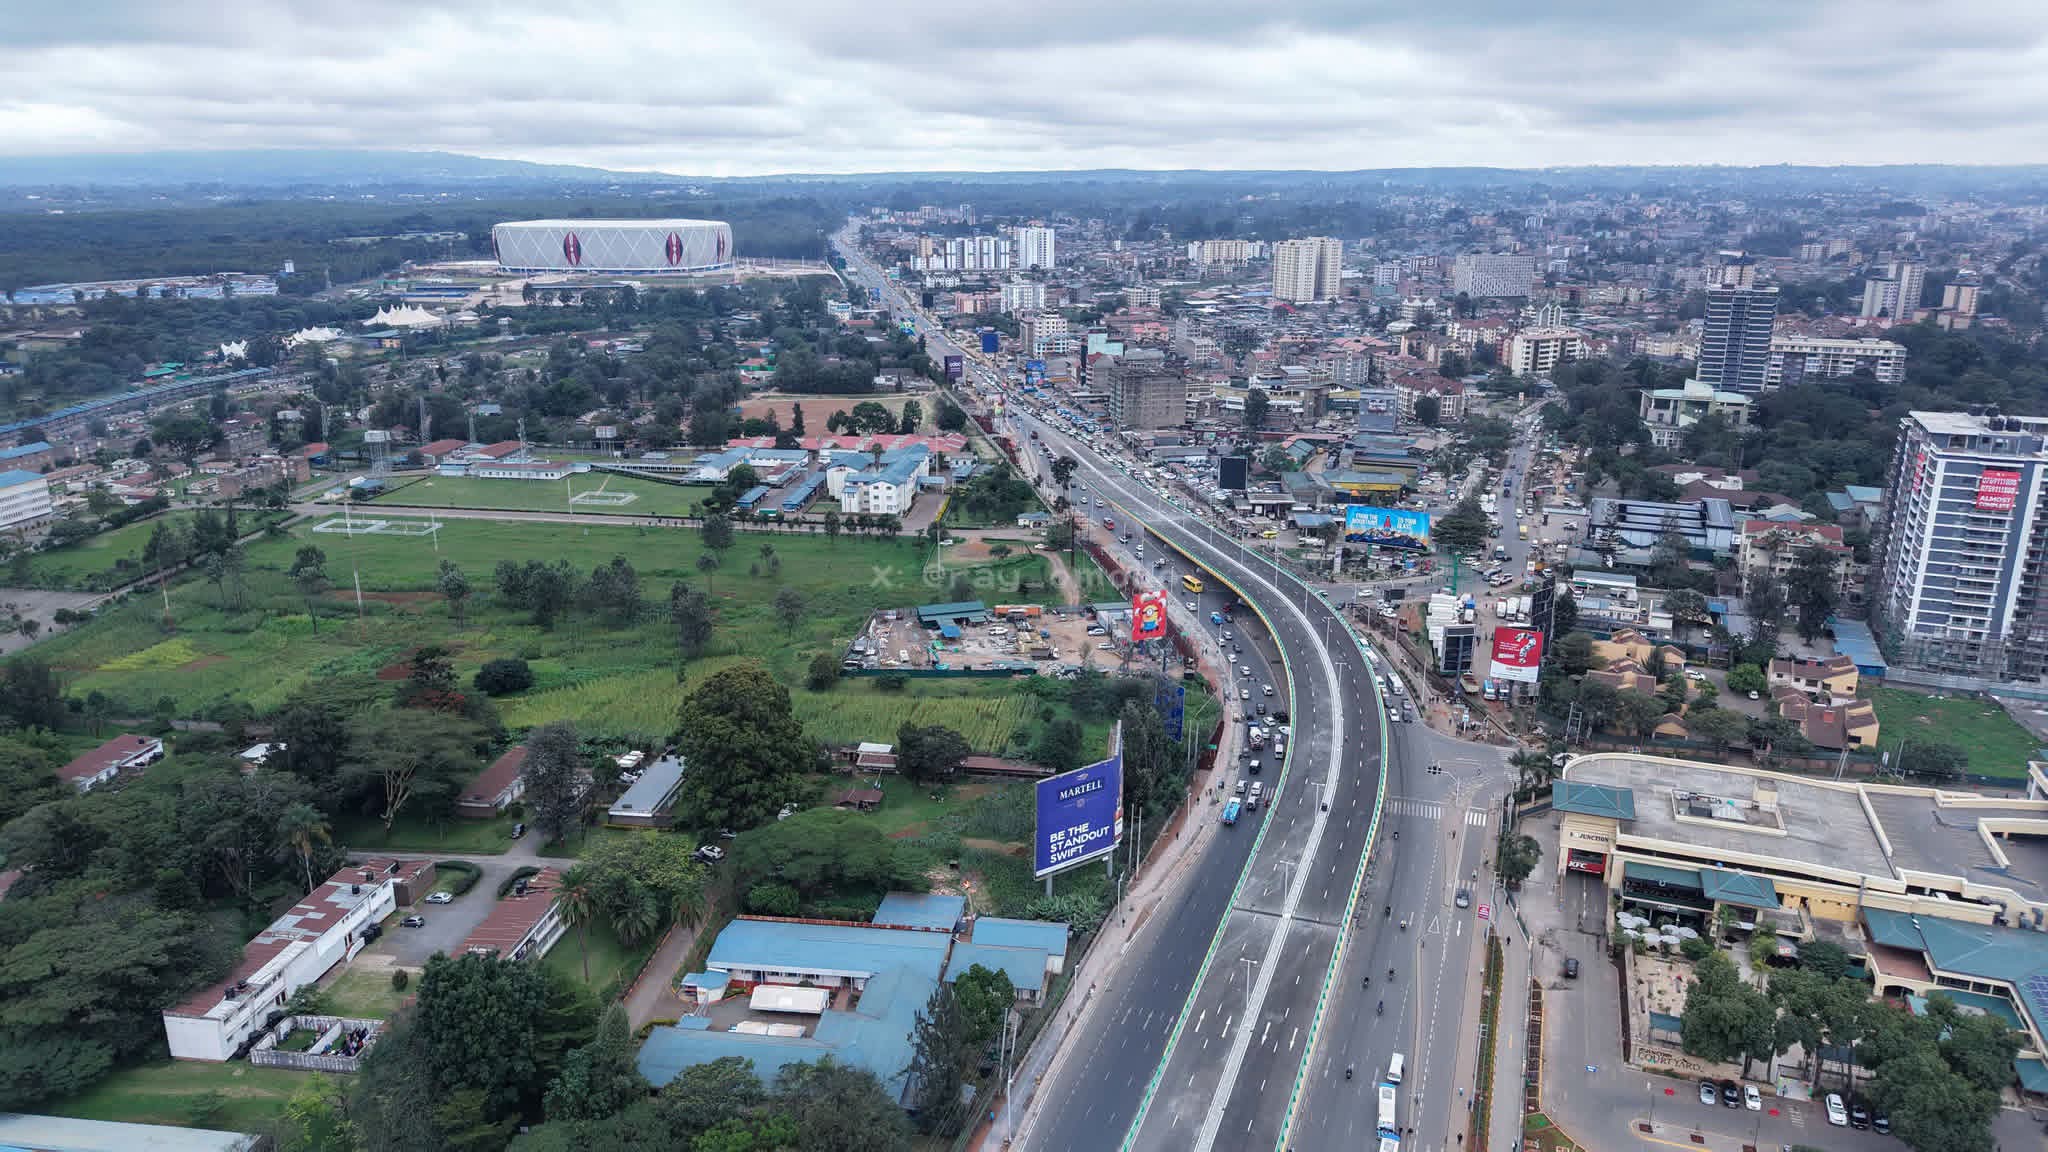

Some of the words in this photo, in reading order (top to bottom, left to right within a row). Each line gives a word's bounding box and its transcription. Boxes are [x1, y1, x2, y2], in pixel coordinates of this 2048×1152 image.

[1059, 780, 1103, 801] MARTELL
[1050, 830, 1065, 843] BE
[1067, 822, 1089, 837] THE
[1050, 825, 1110, 853] STANDOUT
[1579, 833, 1609, 843] JUNCTION
[1050, 845, 1084, 864] SWIFT
[1568, 861, 1588, 869] KFC
